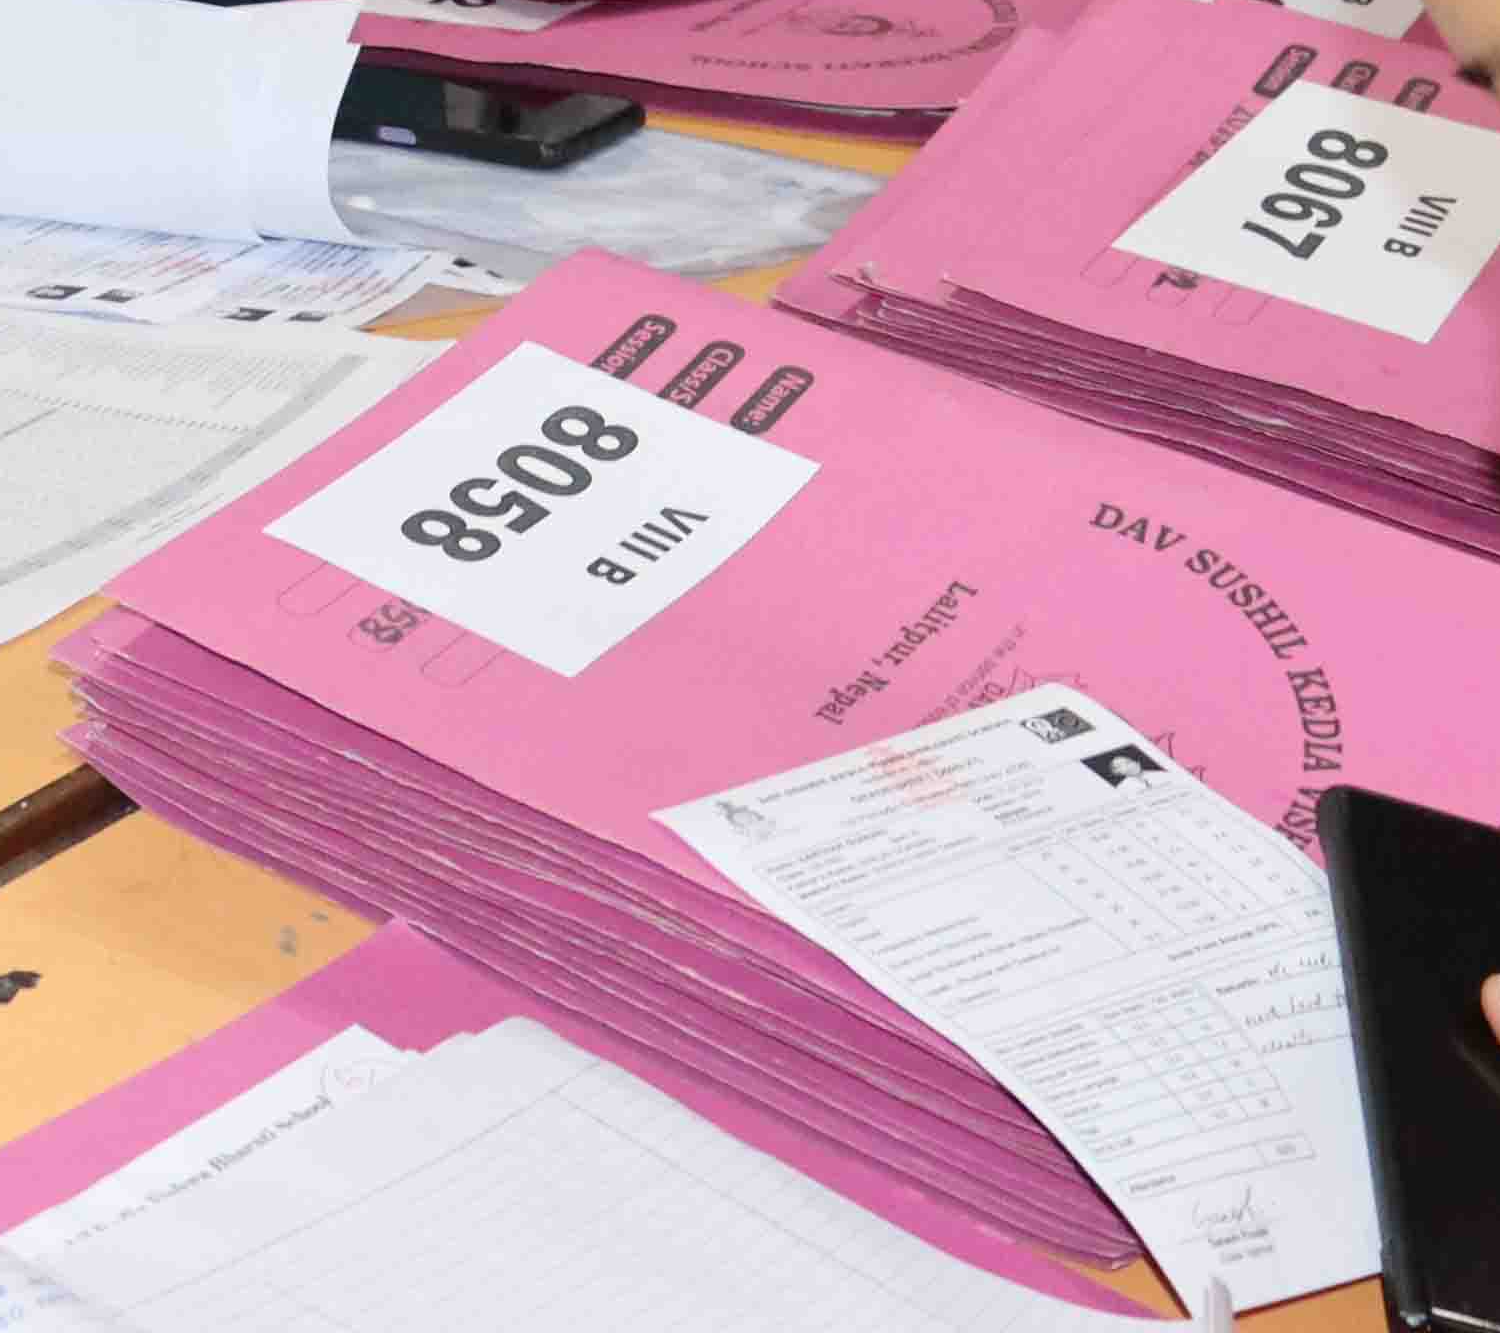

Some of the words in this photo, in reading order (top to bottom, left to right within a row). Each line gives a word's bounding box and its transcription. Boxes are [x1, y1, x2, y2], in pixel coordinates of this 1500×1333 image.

[1241, 129, 1388, 259] 8067
[1400, 194, 1457, 237] VIII
[1384, 237, 1423, 258] B
[400, 405, 639, 563] 8058
[618, 506, 711, 562] VIII
[586, 556, 638, 585] B
[872, 580, 978, 668] Lalitpur,
[1089, 502, 1187, 552] DAV
[1184, 548, 1308, 660] SUSHIL
[1286, 666, 1342, 772] KEDIA
[813, 669, 890, 726] Nepal
